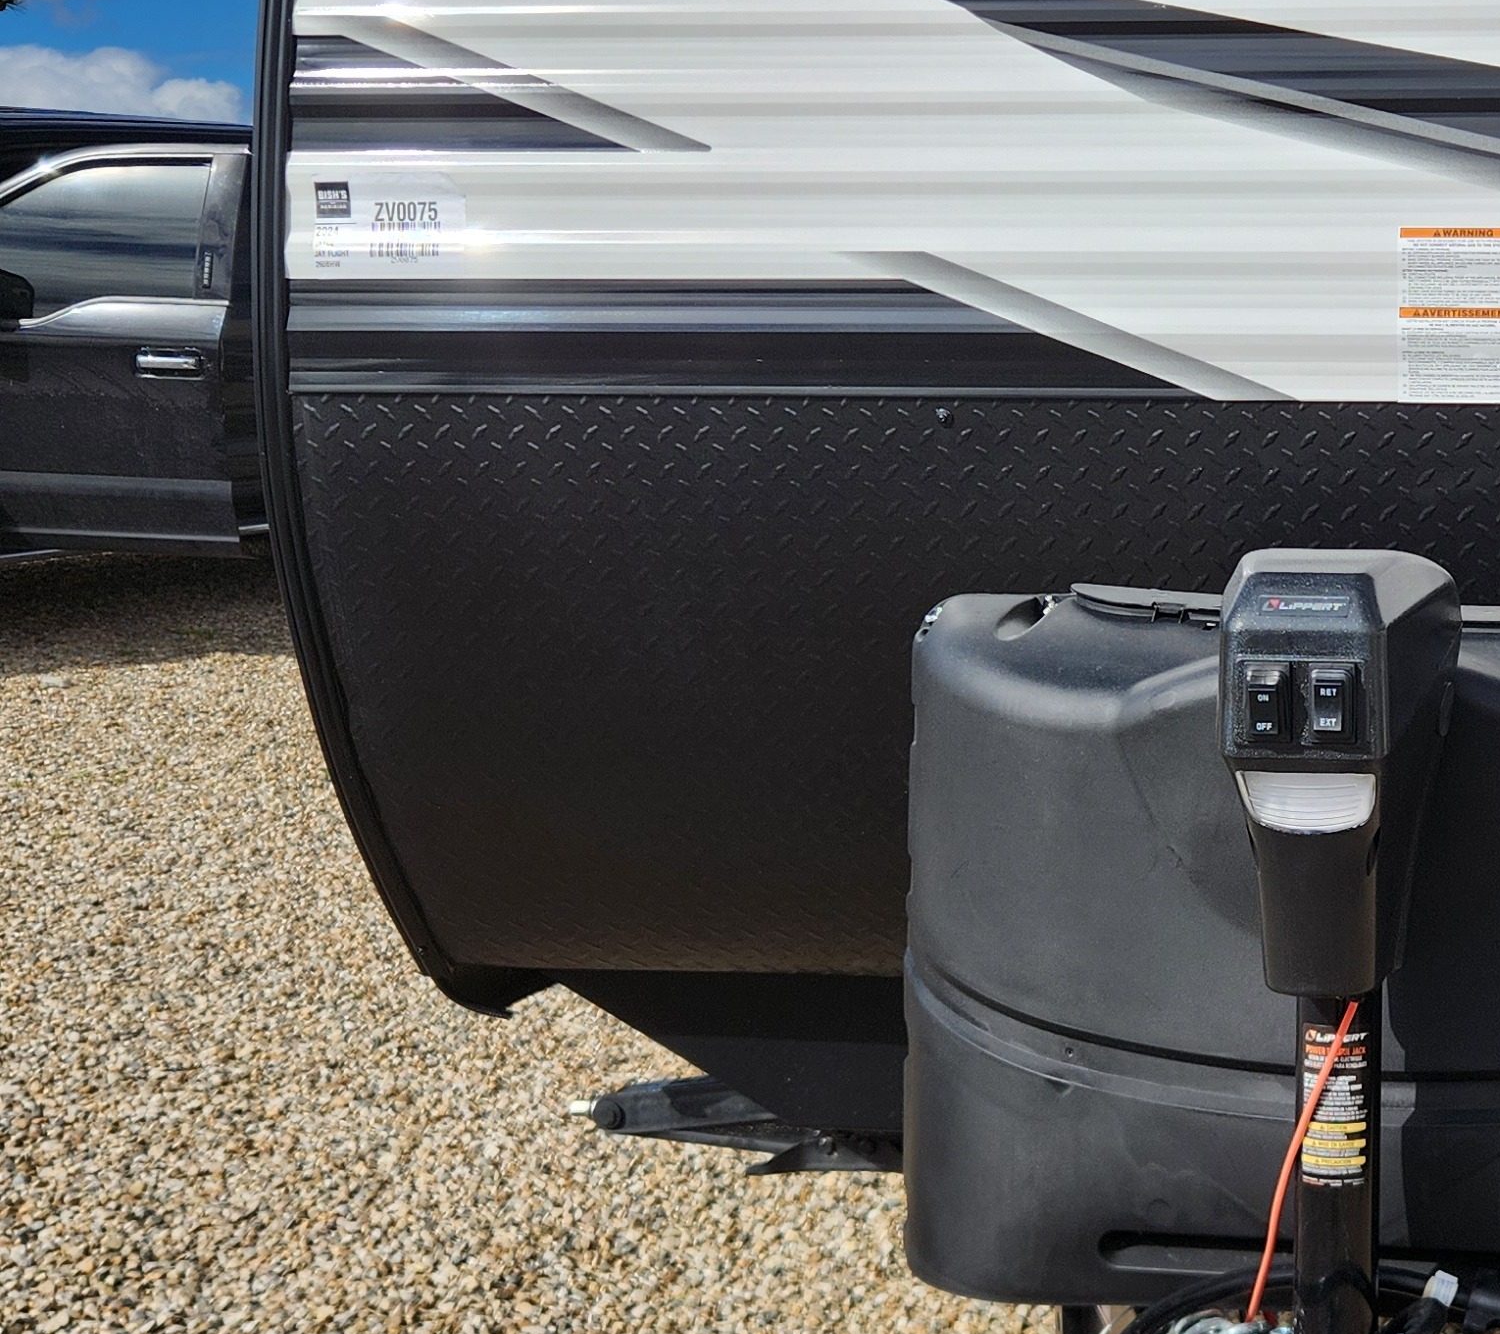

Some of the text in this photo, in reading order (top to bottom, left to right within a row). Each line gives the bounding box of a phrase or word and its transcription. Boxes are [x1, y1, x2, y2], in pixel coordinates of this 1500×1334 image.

[374, 202, 438, 222] ZV0075
[1443, 229, 1494, 237] WARNING
[1320, 687, 1337, 696] RET
[1256, 722, 1272, 730] OFF
[1320, 718, 1336, 726] EXT
[1315, 1031, 1368, 1043] LIPERT
